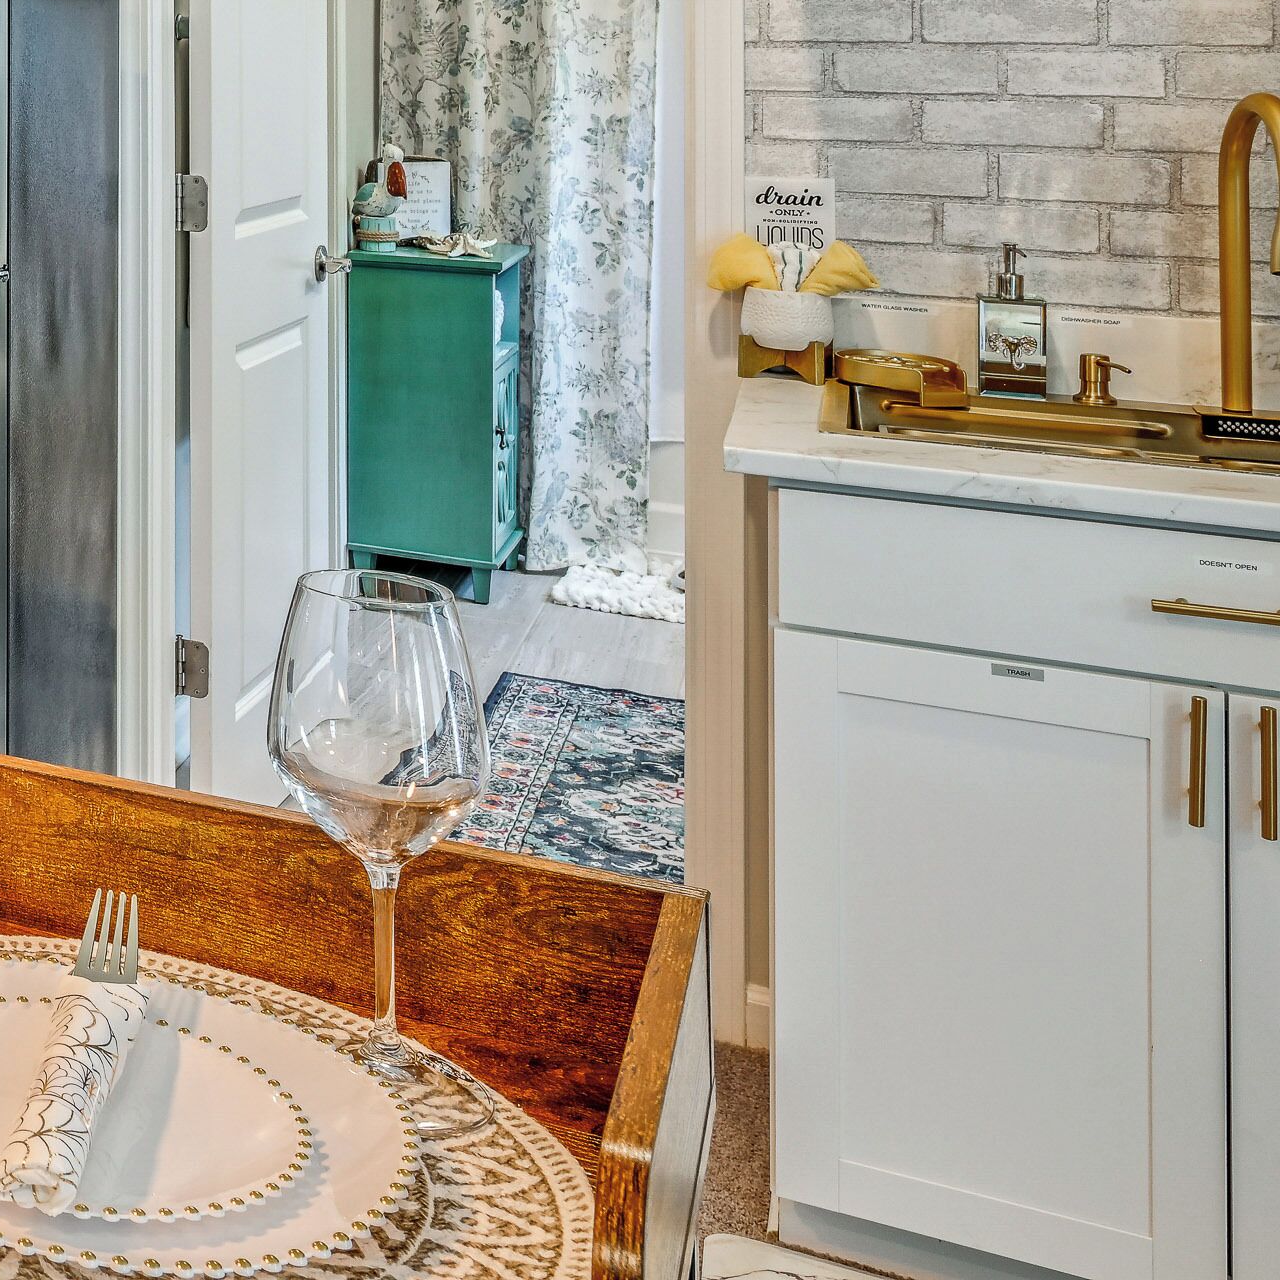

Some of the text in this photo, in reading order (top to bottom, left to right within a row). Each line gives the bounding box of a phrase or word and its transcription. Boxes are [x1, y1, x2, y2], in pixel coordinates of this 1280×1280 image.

[756, 186, 823, 207] drain
[1199, 559, 1233, 568] DOESN'T
[1006, 669, 1030, 677] TRASH
